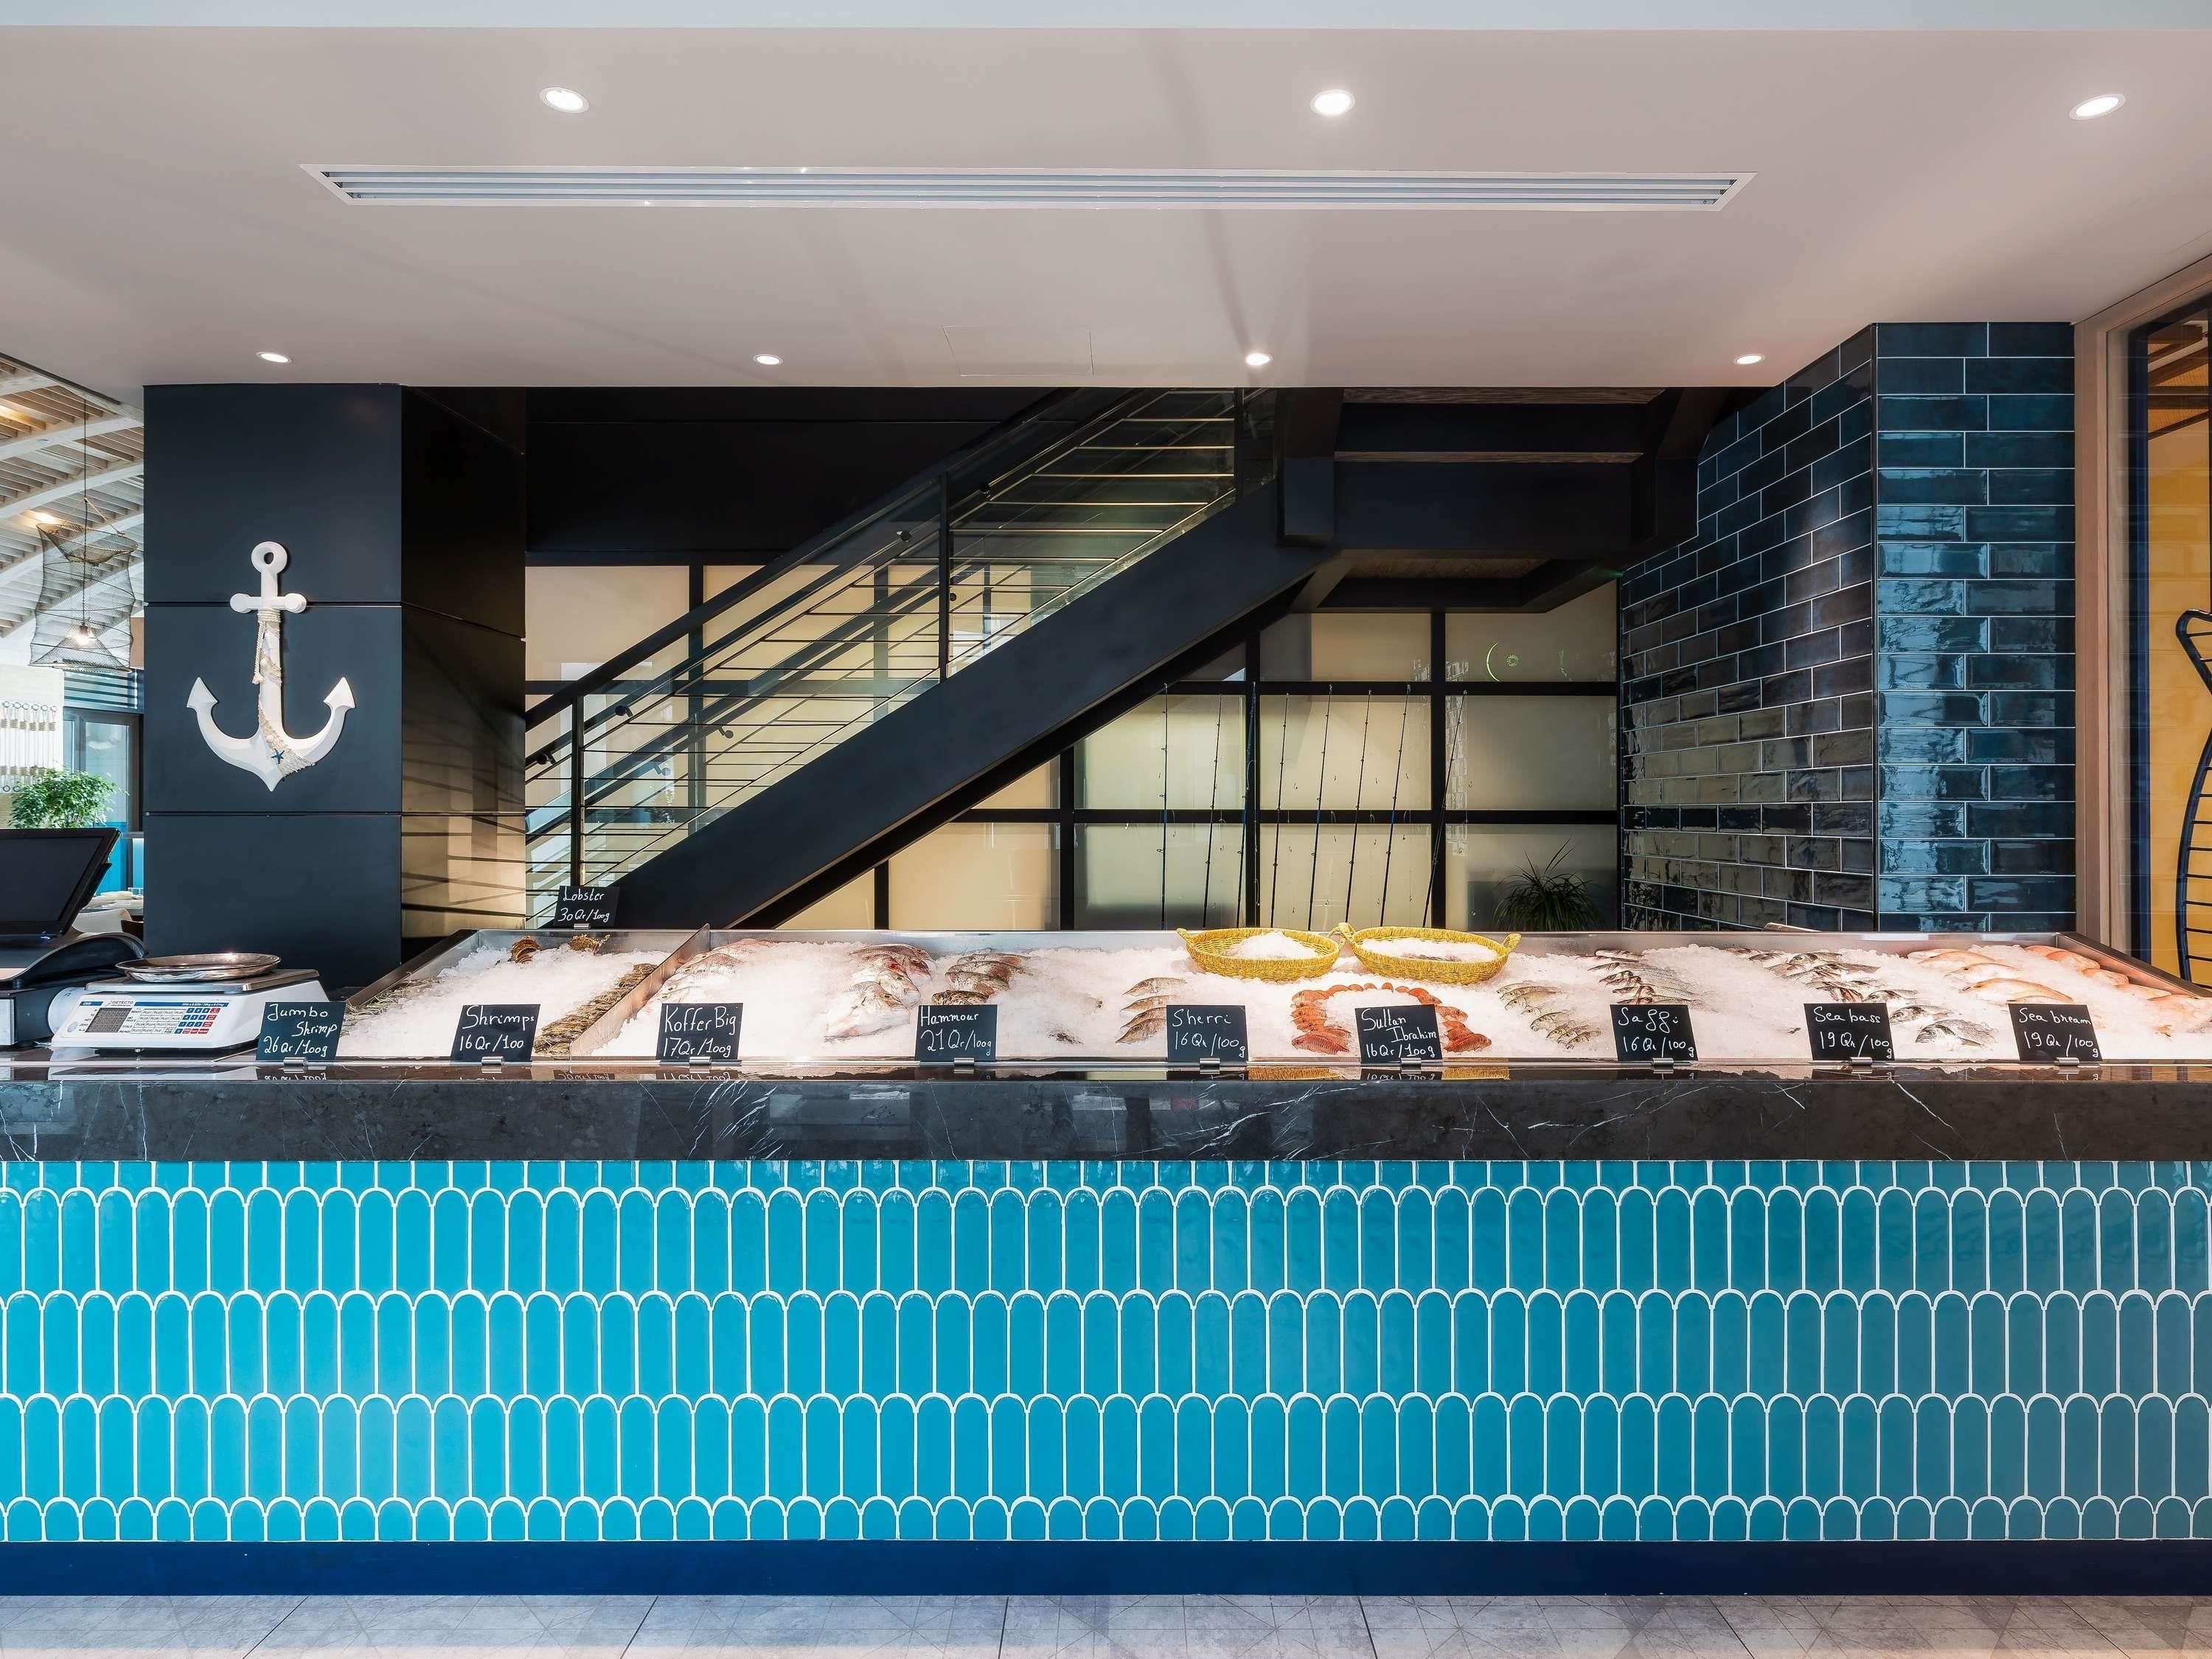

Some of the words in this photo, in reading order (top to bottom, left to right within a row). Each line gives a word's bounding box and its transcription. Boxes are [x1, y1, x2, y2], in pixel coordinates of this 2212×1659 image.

[563, 886, 605, 901] Lobster
[267, 1004, 328, 1021] Jumbo
[462, 1005, 535, 1032] Shrimps
[664, 1005, 712, 1032] Koffer
[714, 1006, 737, 1035] Big
[920, 1005, 979, 1026] Hammour
[1172, 1008, 1231, 1027] Sherri
[1361, 1008, 1406, 1032] Sultan
[1813, 1006, 1846, 1022] Sea
[1848, 1008, 1881, 1023] bass
[2019, 1007, 2048, 1023] Sea
[2050, 1010, 2092, 1025] bream
[291, 1021, 338, 1037] Shrimp
[1385, 1026, 1437, 1043] Ibrahim
